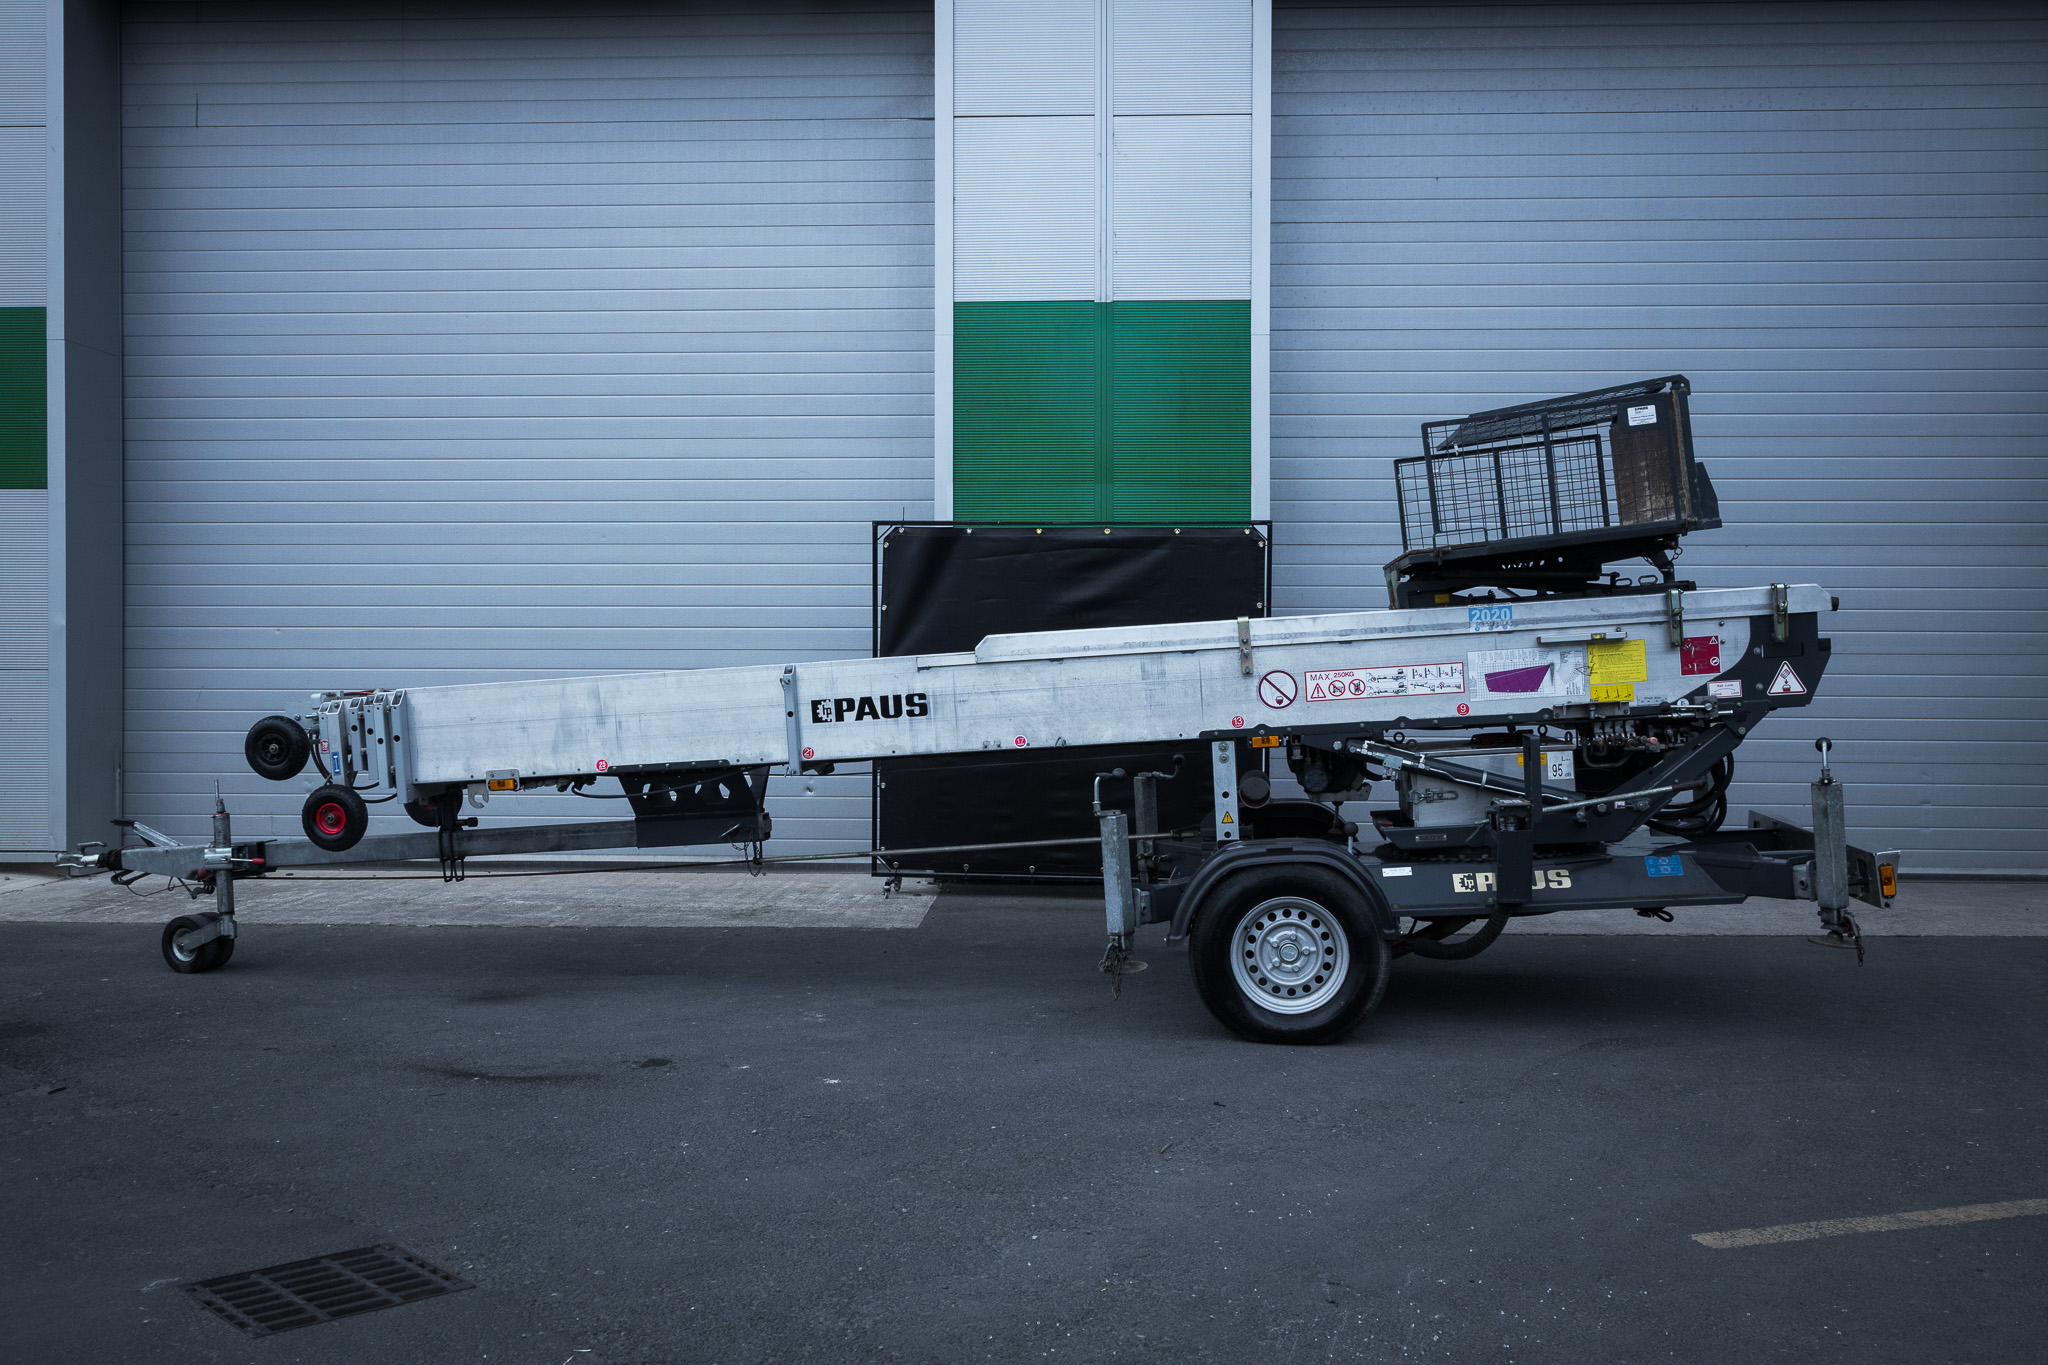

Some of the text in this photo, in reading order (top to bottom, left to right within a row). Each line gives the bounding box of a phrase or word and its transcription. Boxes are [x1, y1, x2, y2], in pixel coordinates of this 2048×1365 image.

[1471, 608, 1511, 623] 2020
[834, 692, 928, 723] PAUS
[1233, 716, 1243, 725] 13
[1551, 763, 1564, 777] 95
[1475, 869, 1572, 892] PUS
